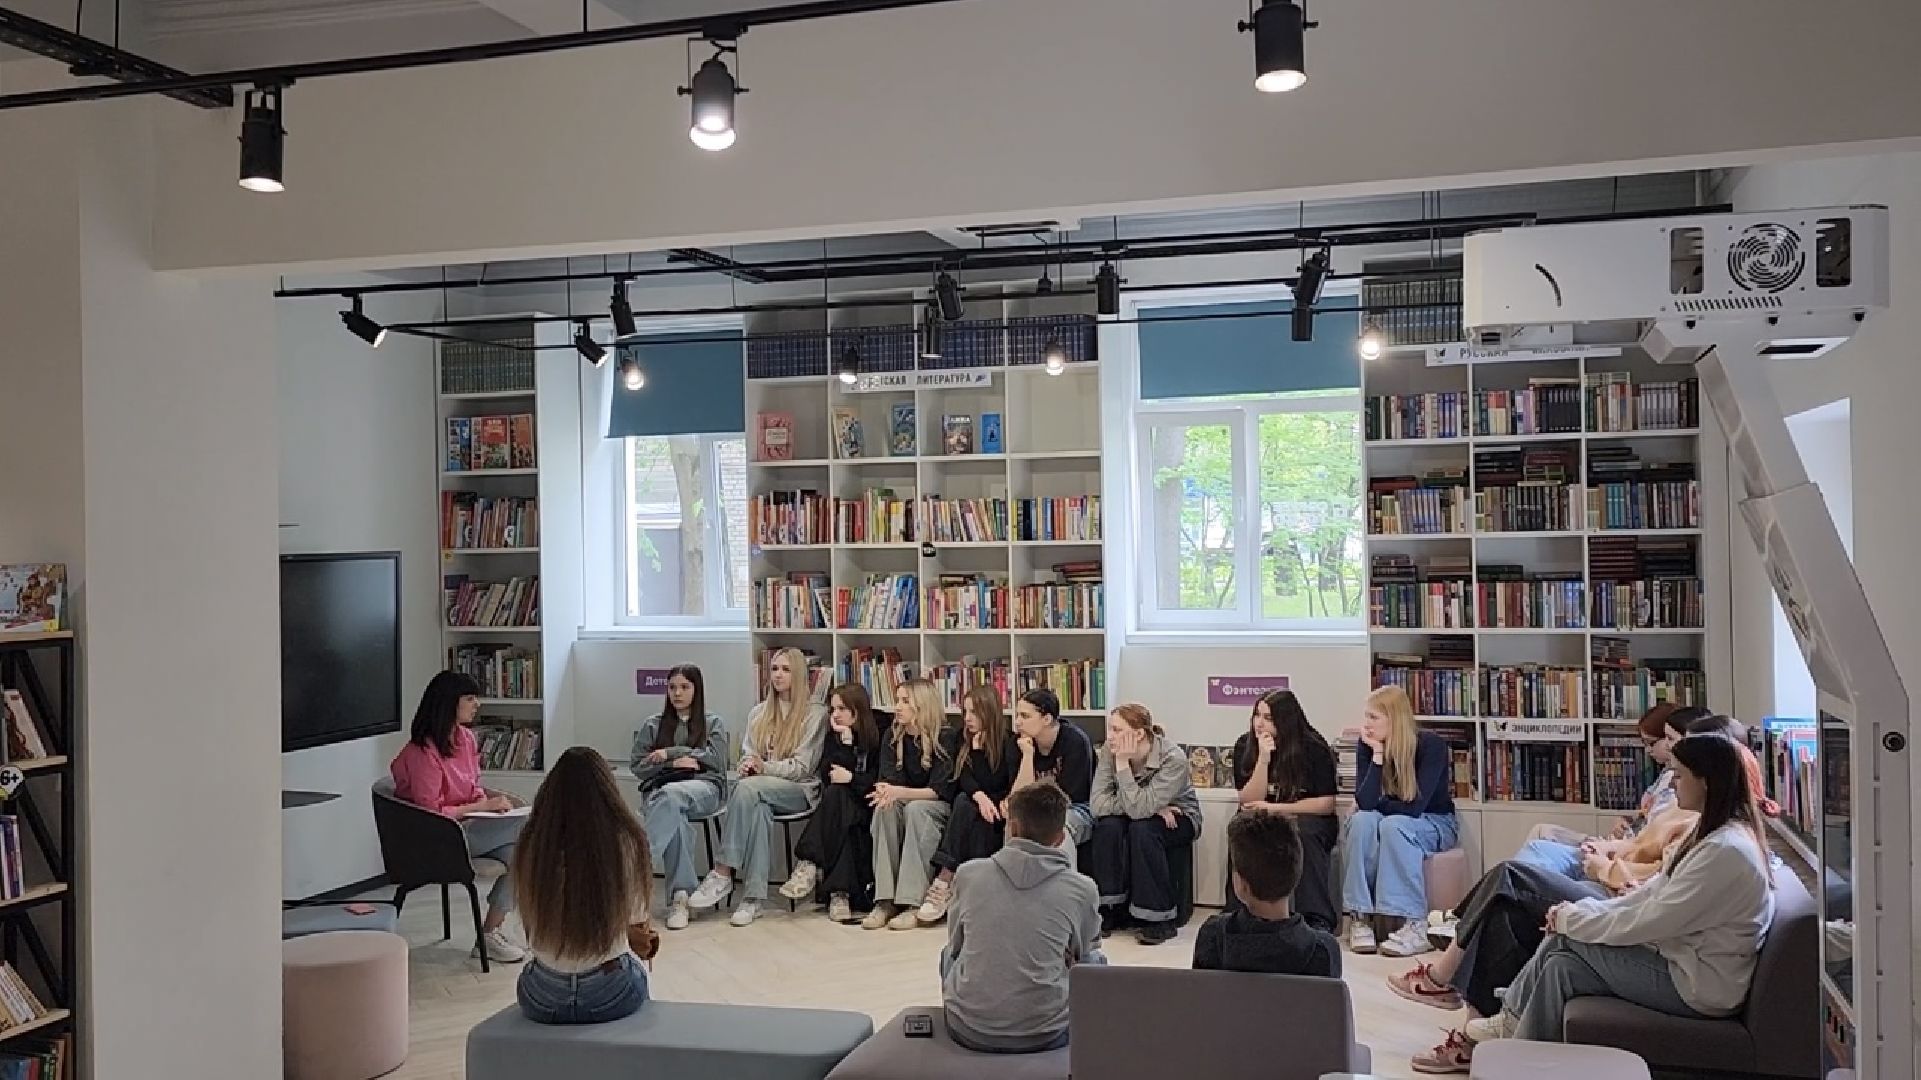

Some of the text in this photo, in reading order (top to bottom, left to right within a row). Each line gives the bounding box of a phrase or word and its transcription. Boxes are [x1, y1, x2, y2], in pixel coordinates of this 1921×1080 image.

[916, 372, 972, 385] ЛИТЕРАТУРА
[1222, 683, 1271, 695] Фэнтез
[1511, 724, 1582, 735] ЭНЦИКЛОПЕДИИ
[0, 769, 20, 786] 6+
